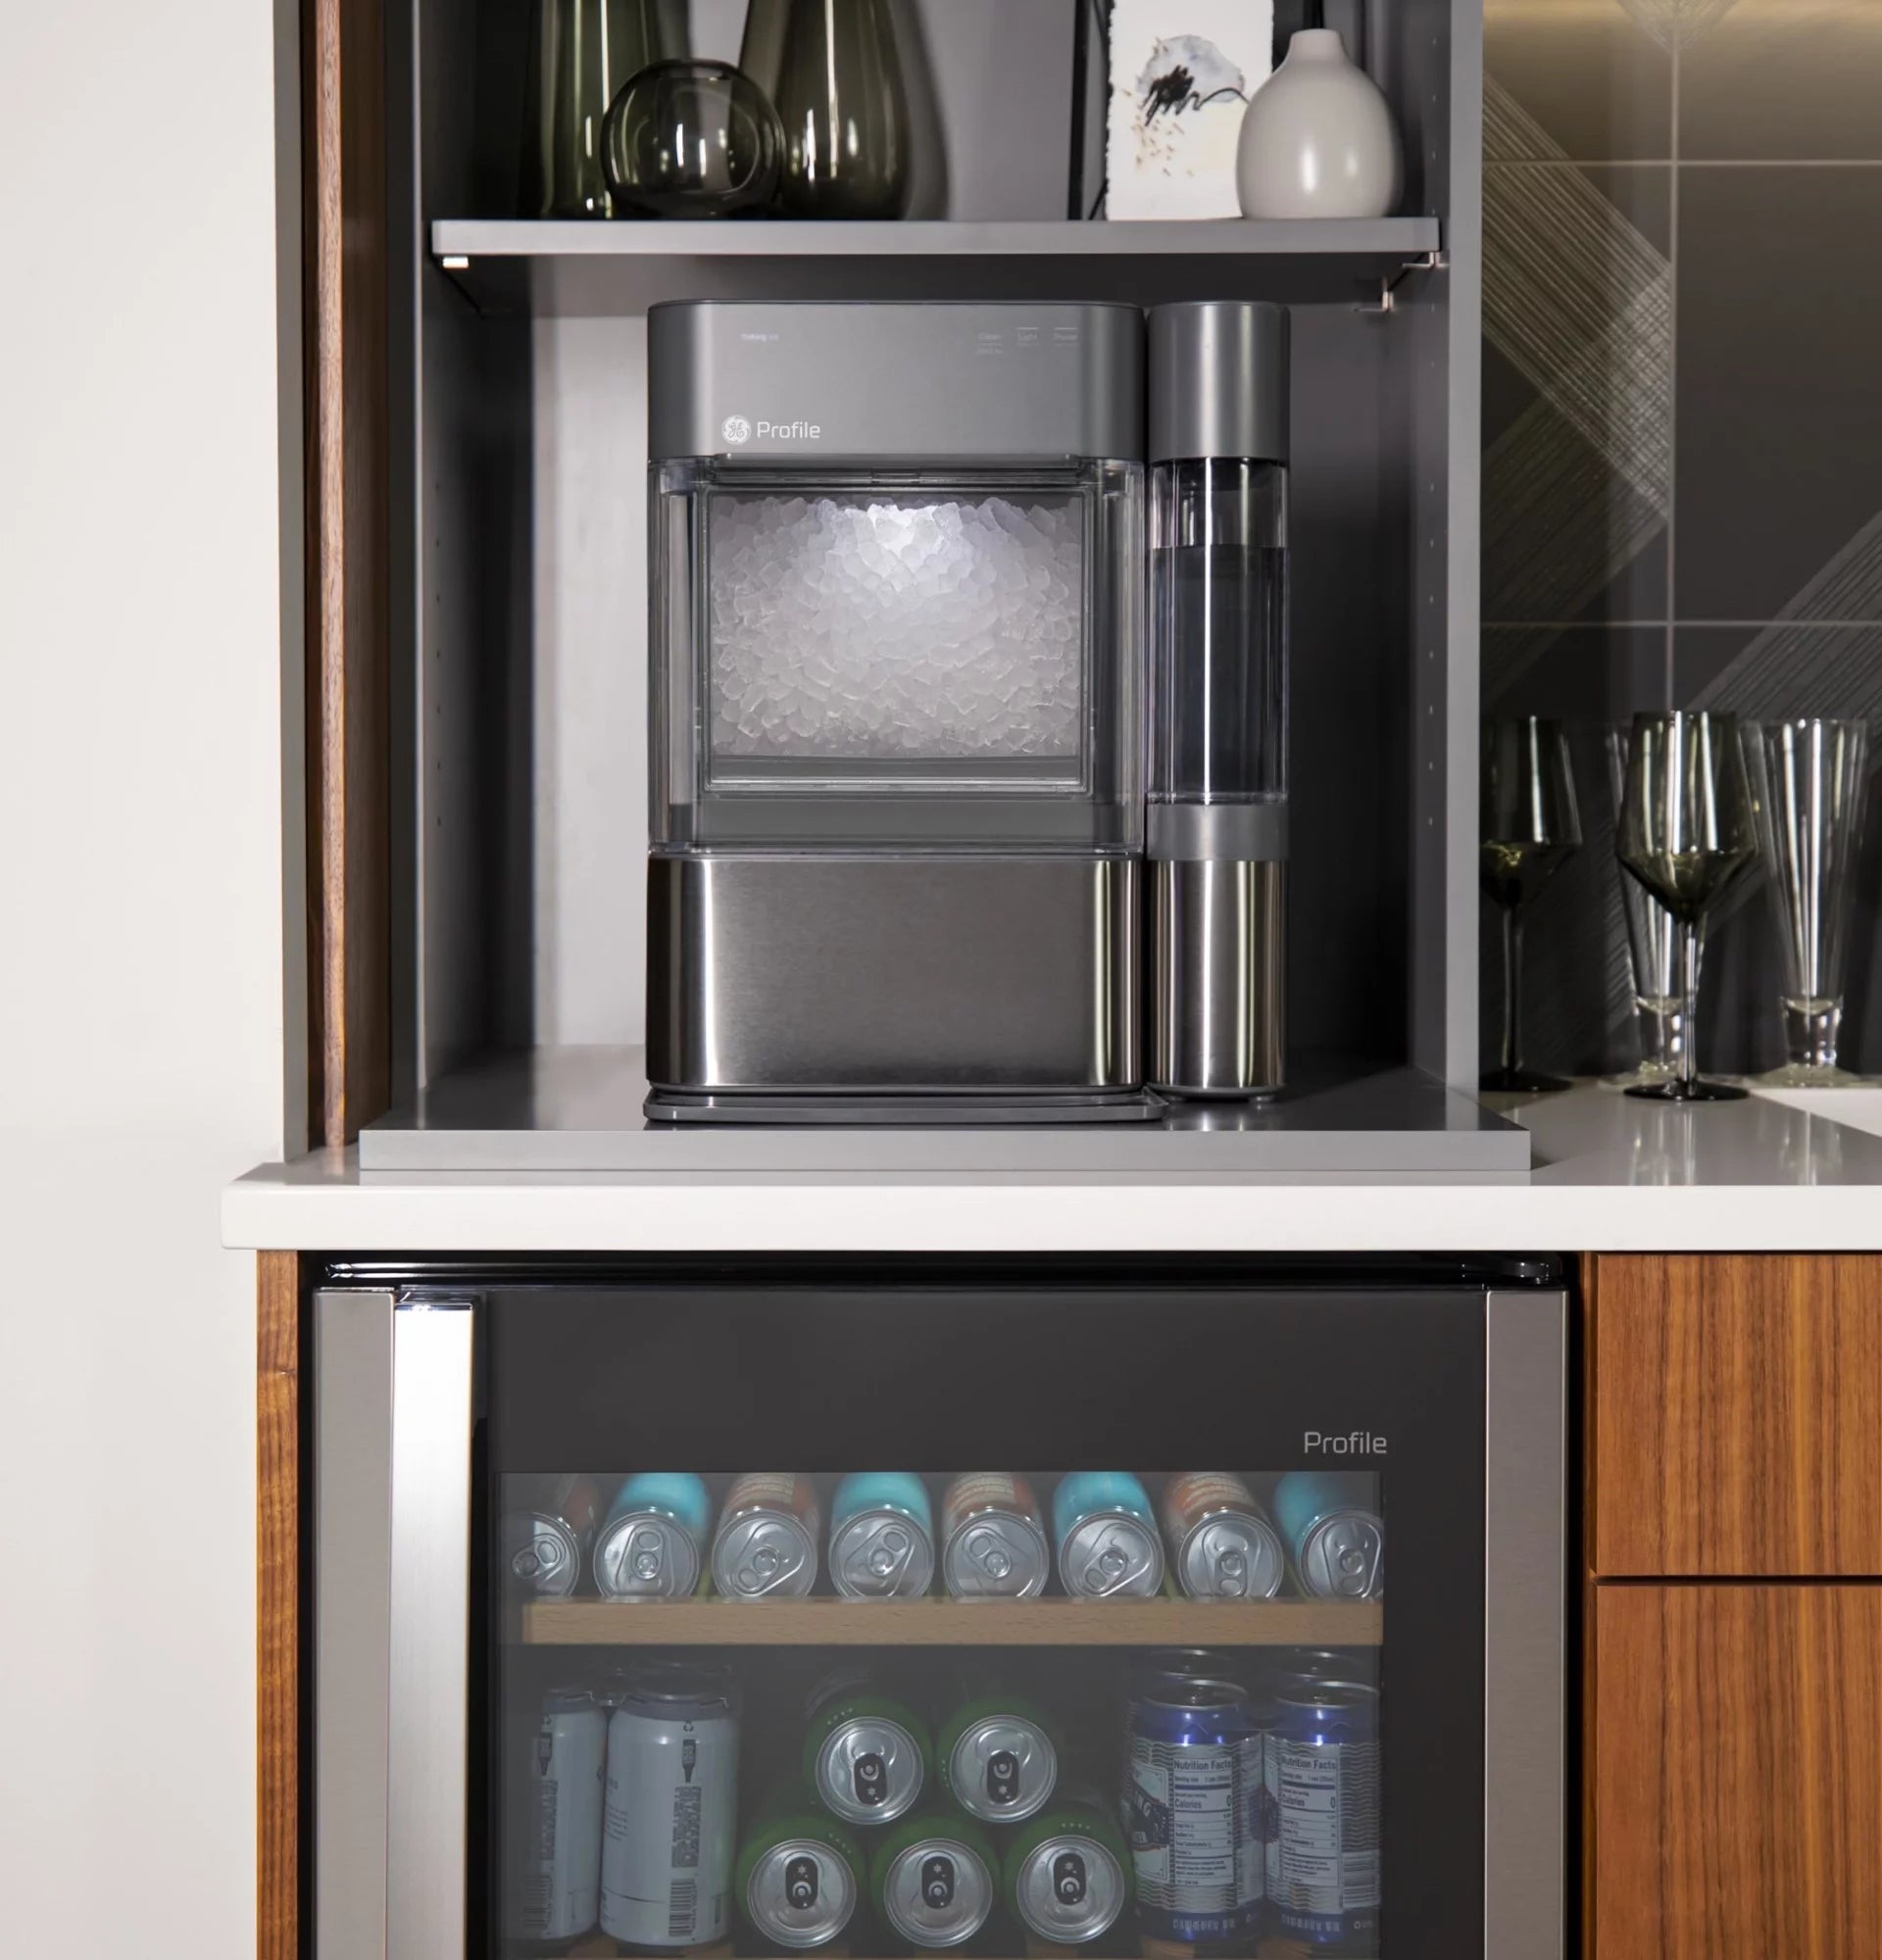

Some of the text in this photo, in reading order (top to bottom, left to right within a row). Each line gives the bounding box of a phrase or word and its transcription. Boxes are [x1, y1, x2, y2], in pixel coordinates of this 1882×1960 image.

[757, 421, 820, 439] Profile
[1304, 1431, 1387, 1454] Profile
[1174, 1759, 1232, 1770] Nutrition Facts
[1313, 1759, 1336, 1769] Facts
